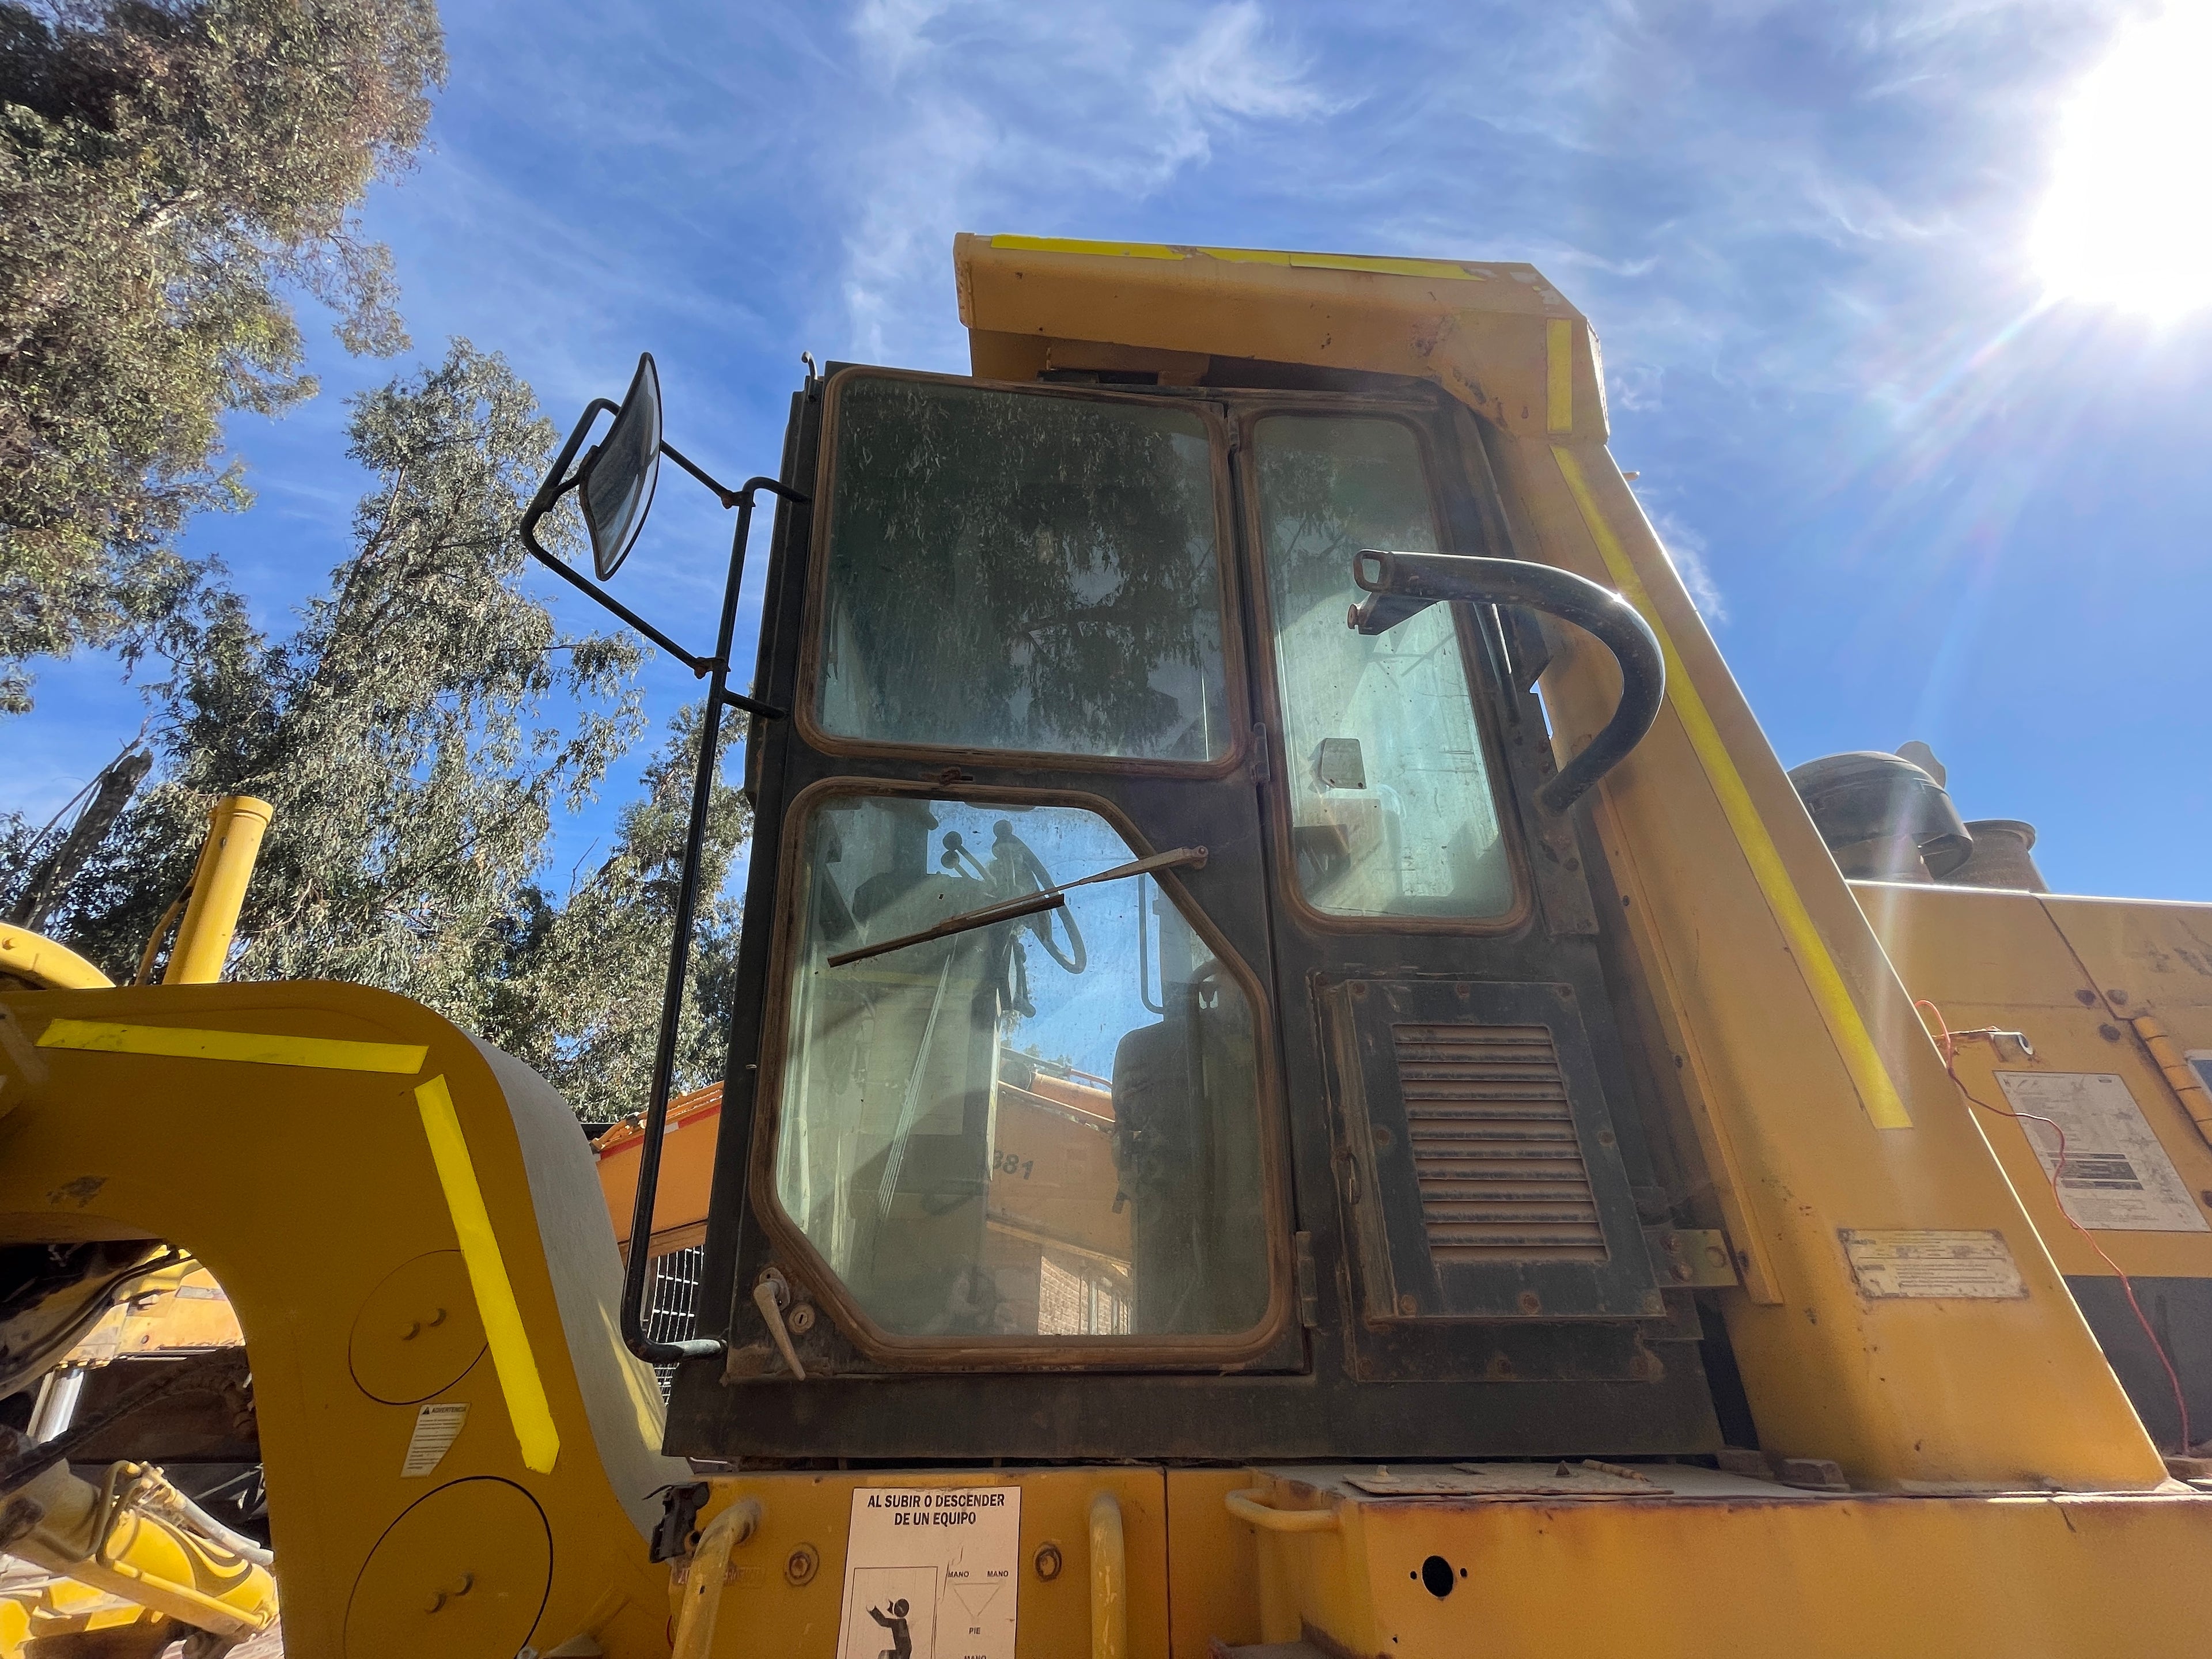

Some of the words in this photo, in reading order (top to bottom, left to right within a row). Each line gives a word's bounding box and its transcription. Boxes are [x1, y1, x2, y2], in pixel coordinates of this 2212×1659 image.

[868, 1495, 882, 1508] AL
[884, 1495, 921, 1508] SUBIR
[924, 1495, 932, 1508] O
[935, 1494, 1005, 1507] DESCENDER
[895, 1512, 911, 1525] DE
[913, 1512, 930, 1525] UN
[933, 1512, 976, 1527] EQUIPO
[969, 1627, 981, 1635] PIE
